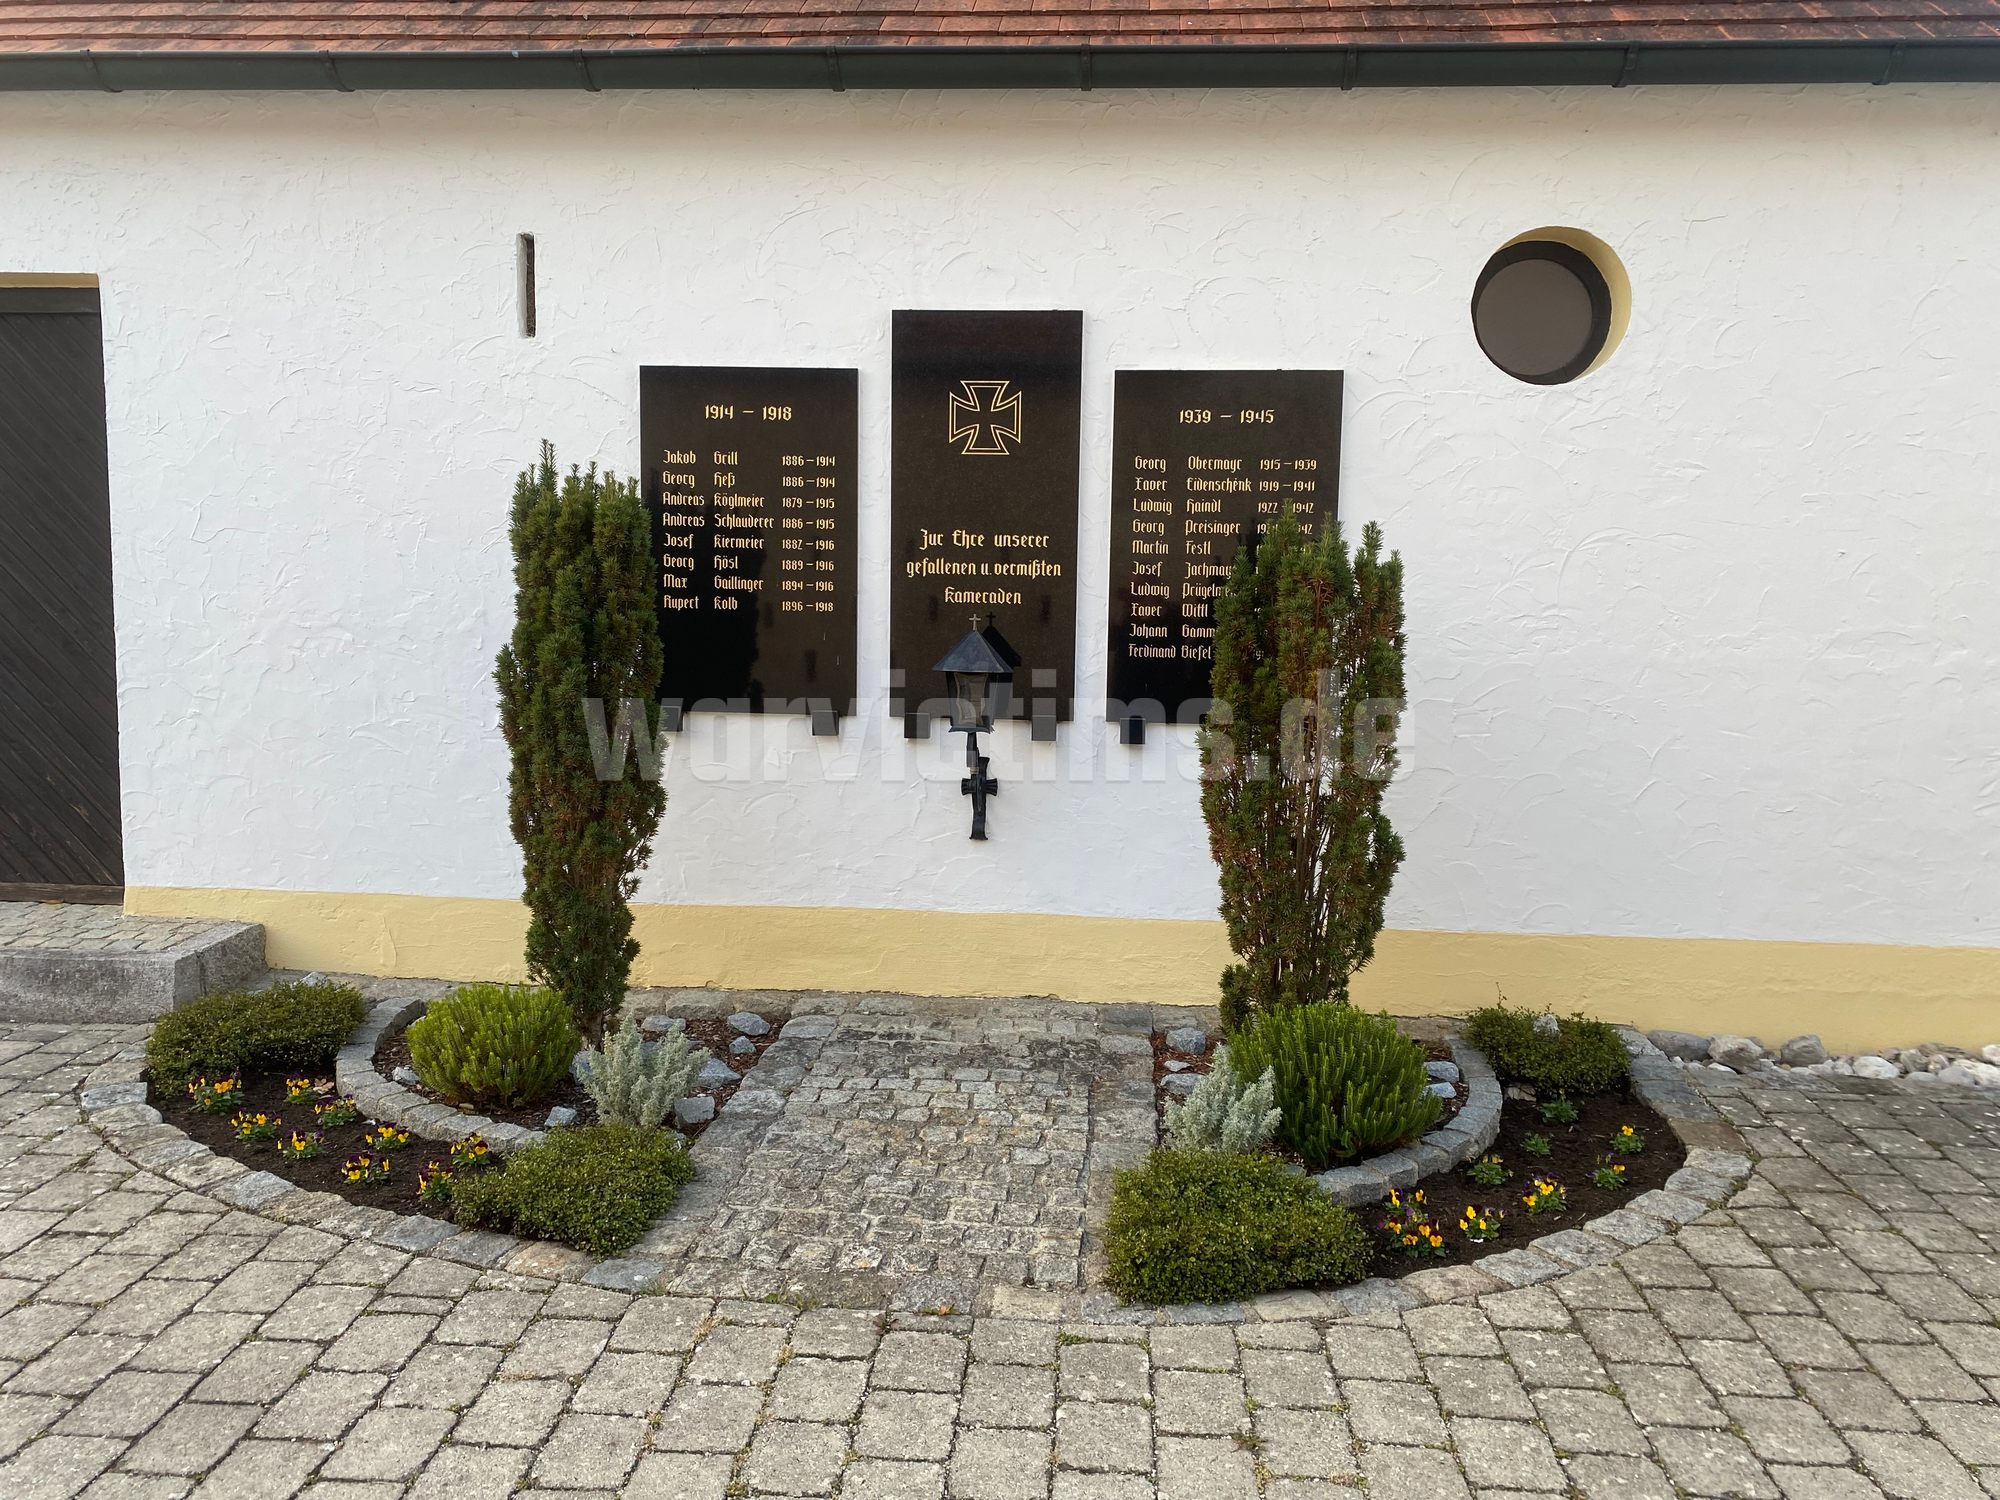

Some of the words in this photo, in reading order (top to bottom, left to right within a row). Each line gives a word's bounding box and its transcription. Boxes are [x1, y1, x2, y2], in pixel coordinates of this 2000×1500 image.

[705, 405, 733, 419] 1914
[763, 406, 791, 421] 1918
[1180, 410, 1211, 423] 1939
[1241, 410, 1274, 423] 1945
[663, 450, 696, 464] Jakob
[714, 451, 737, 465] Grill
[1135, 456, 1166, 473] Georg
[1188, 456, 1242, 473] Obermayr
[663, 471, 695, 488] Georg
[663, 492, 704, 505] Andreas
[1134, 498, 1172, 515] Ludwig
[663, 512, 704, 526] Andreas
[1133, 519, 1164, 536] Georg
[664, 533, 693, 549] Josef
[714, 534, 764, 549] Kiermeier
[920, 529, 943, 550] Zur
[952, 530, 984, 549] Ehre
[994, 535, 1049, 547] unserer
[1133, 540, 1168, 554] Martin
[1186, 541, 1210, 554] Festl
[664, 554, 693, 570] Georg
[907, 558, 976, 577] gefallenen
[995, 560, 1061, 579] vermißten
[1132, 561, 1163, 577] Josef
[1185, 562, 1237, 579] Zachmay
[664, 574, 687, 588] Max
[945, 587, 1021, 604] Kameraden
[1131, 582, 1169, 599] Ludwig
[664, 595, 699, 610] Rupert
[1182, 604, 1207, 617] Wittl
[1130, 624, 1167, 638] Johann
[1182, 624, 1216, 638] Gamm
[1129, 644, 1175, 658] Ferdinand
